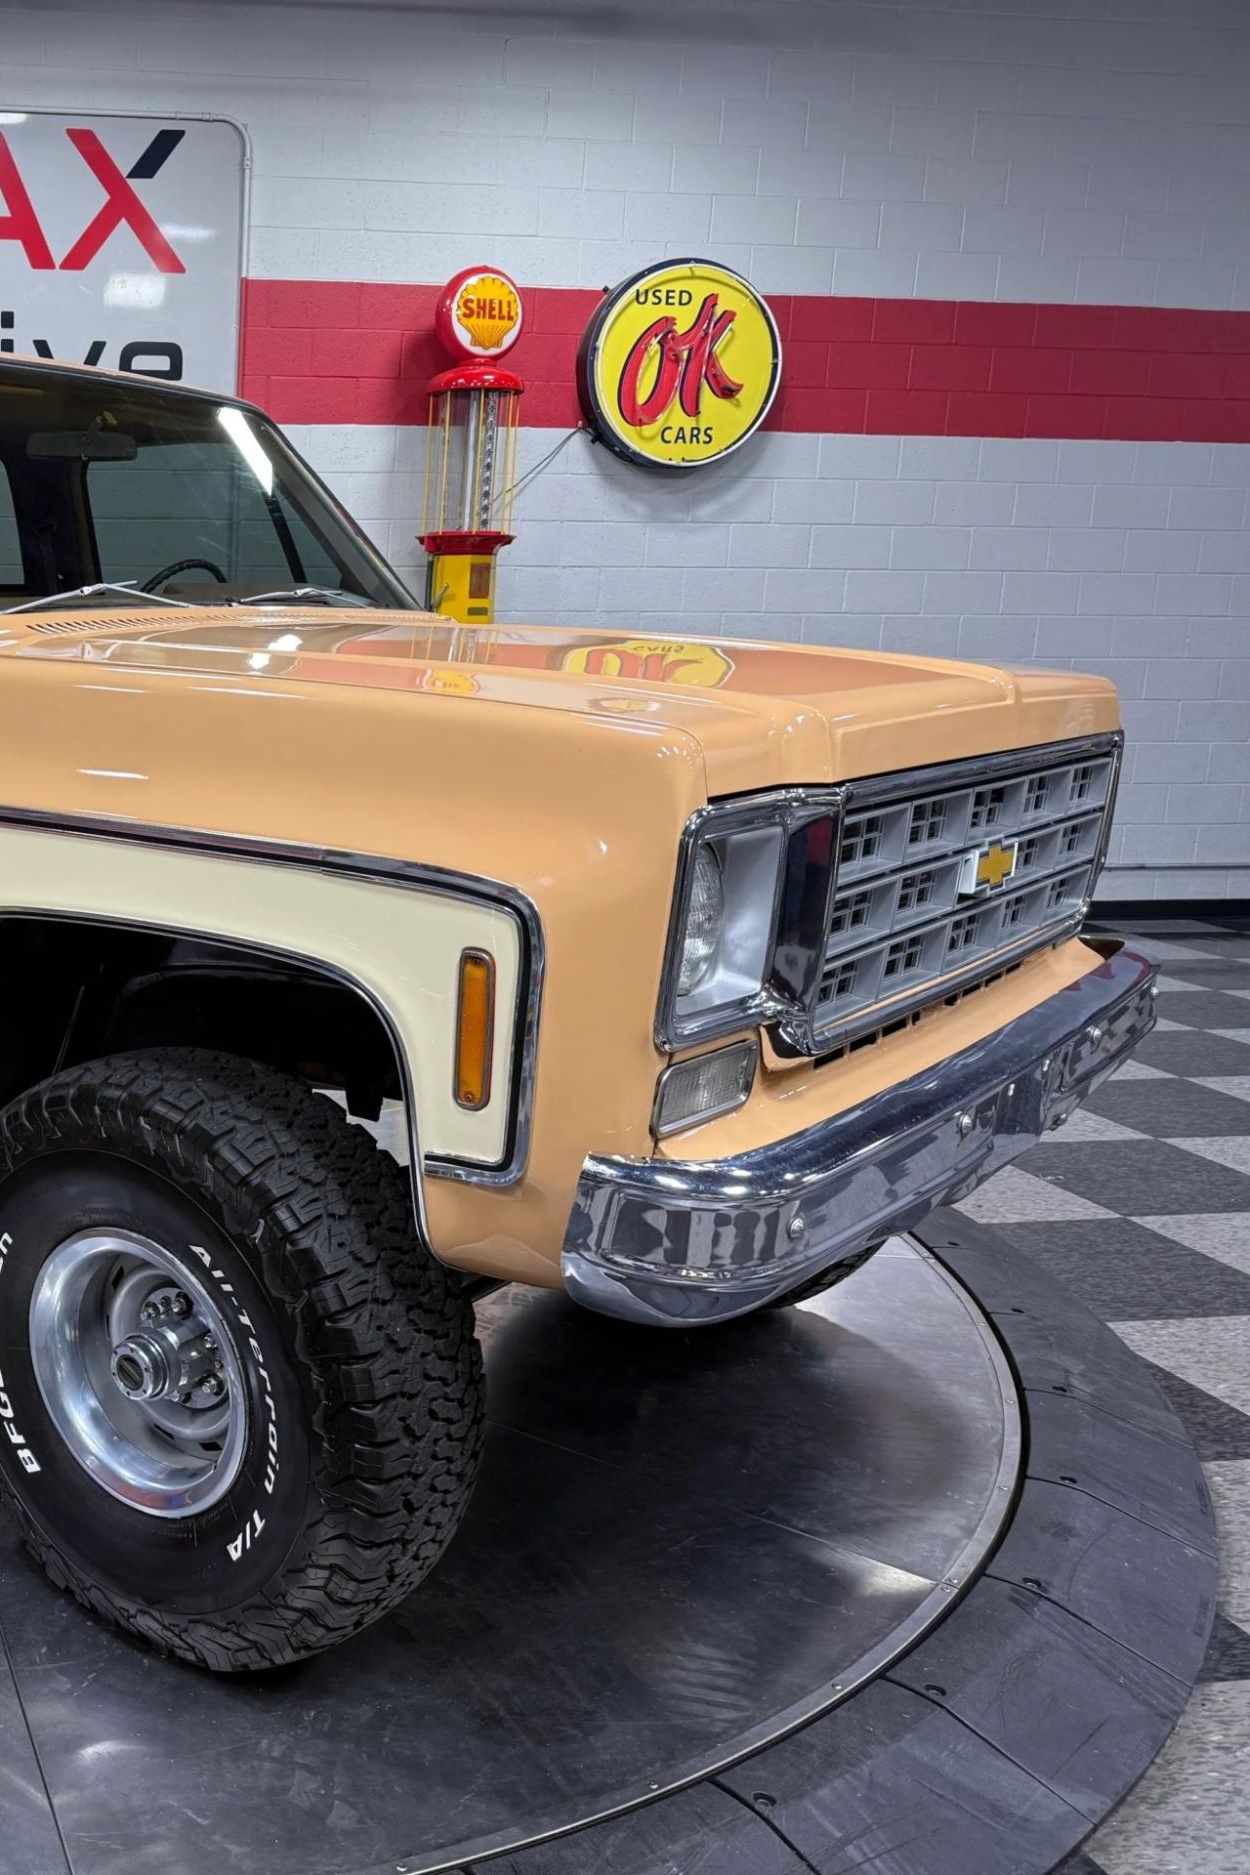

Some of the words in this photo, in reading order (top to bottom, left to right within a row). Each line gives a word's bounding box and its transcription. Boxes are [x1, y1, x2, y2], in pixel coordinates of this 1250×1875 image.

[462, 297, 515, 322] SHELL
[634, 288, 693, 306] USED
[661, 427, 713, 445] CARS
[189, 1244, 279, 1495] All-Terrain
[227, 1509, 266, 1562] T/A
